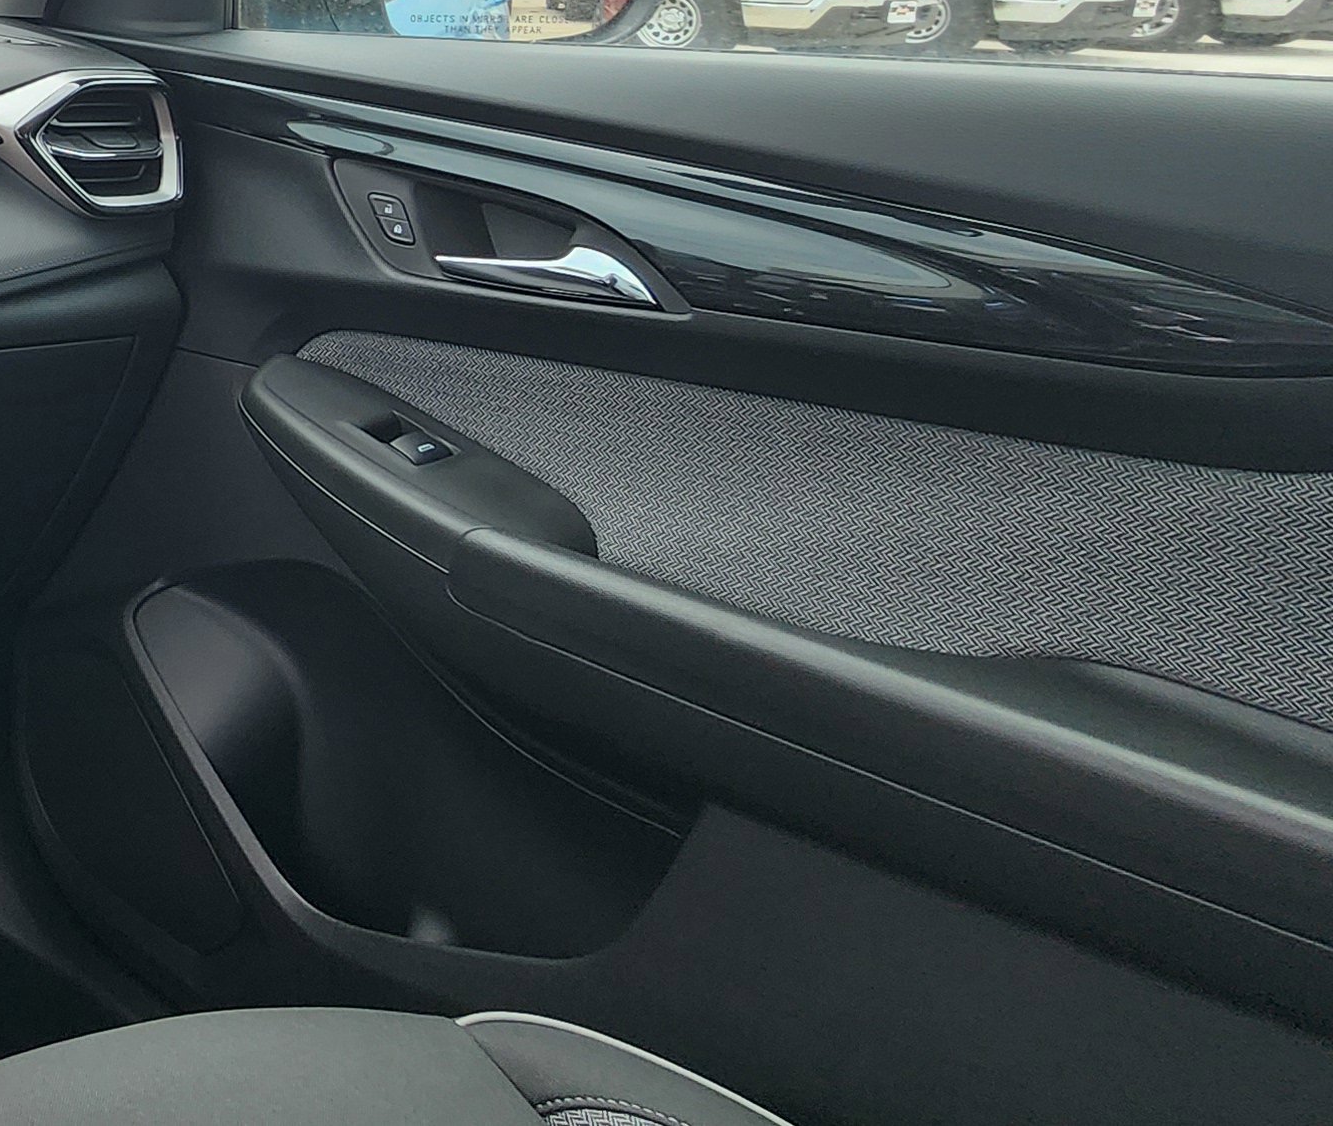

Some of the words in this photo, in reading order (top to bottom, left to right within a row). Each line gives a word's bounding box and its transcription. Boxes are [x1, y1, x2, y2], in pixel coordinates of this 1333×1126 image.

[410, 14, 455, 23] OBJECTS
[459, 15, 469, 23] IN
[472, 15, 508, 24] MIRRO
[515, 15, 533, 24] ARE
[539, 15, 576, 25] CLOSE
[445, 25, 469, 34] THAN
[475, 25, 500, 34] THEY
[506, 26, 542, 34] APPEAR
